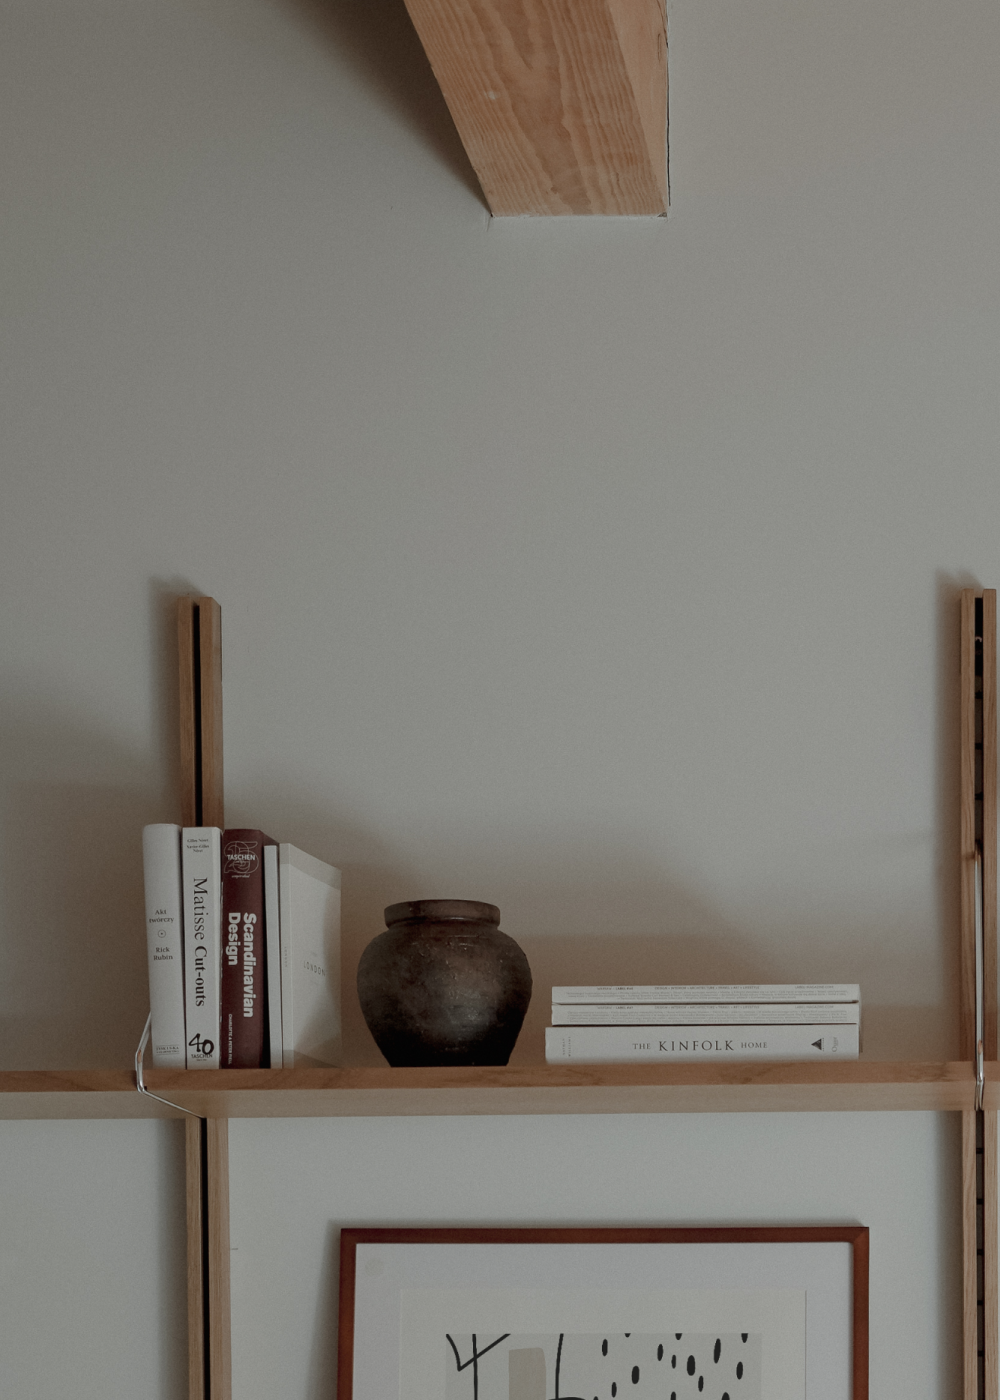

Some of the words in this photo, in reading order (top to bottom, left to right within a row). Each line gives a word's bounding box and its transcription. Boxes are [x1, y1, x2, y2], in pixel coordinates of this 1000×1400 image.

[193, 877, 209, 941] Matisse
[225, 912, 242, 966] Design
[243, 912, 257, 1018] Scandinavian
[194, 946, 208, 1007] Cut-outs
[188, 1033, 215, 1055] 40
[658, 1040, 735, 1052] KINFOLK
[741, 1042, 769, 1050] HOME
